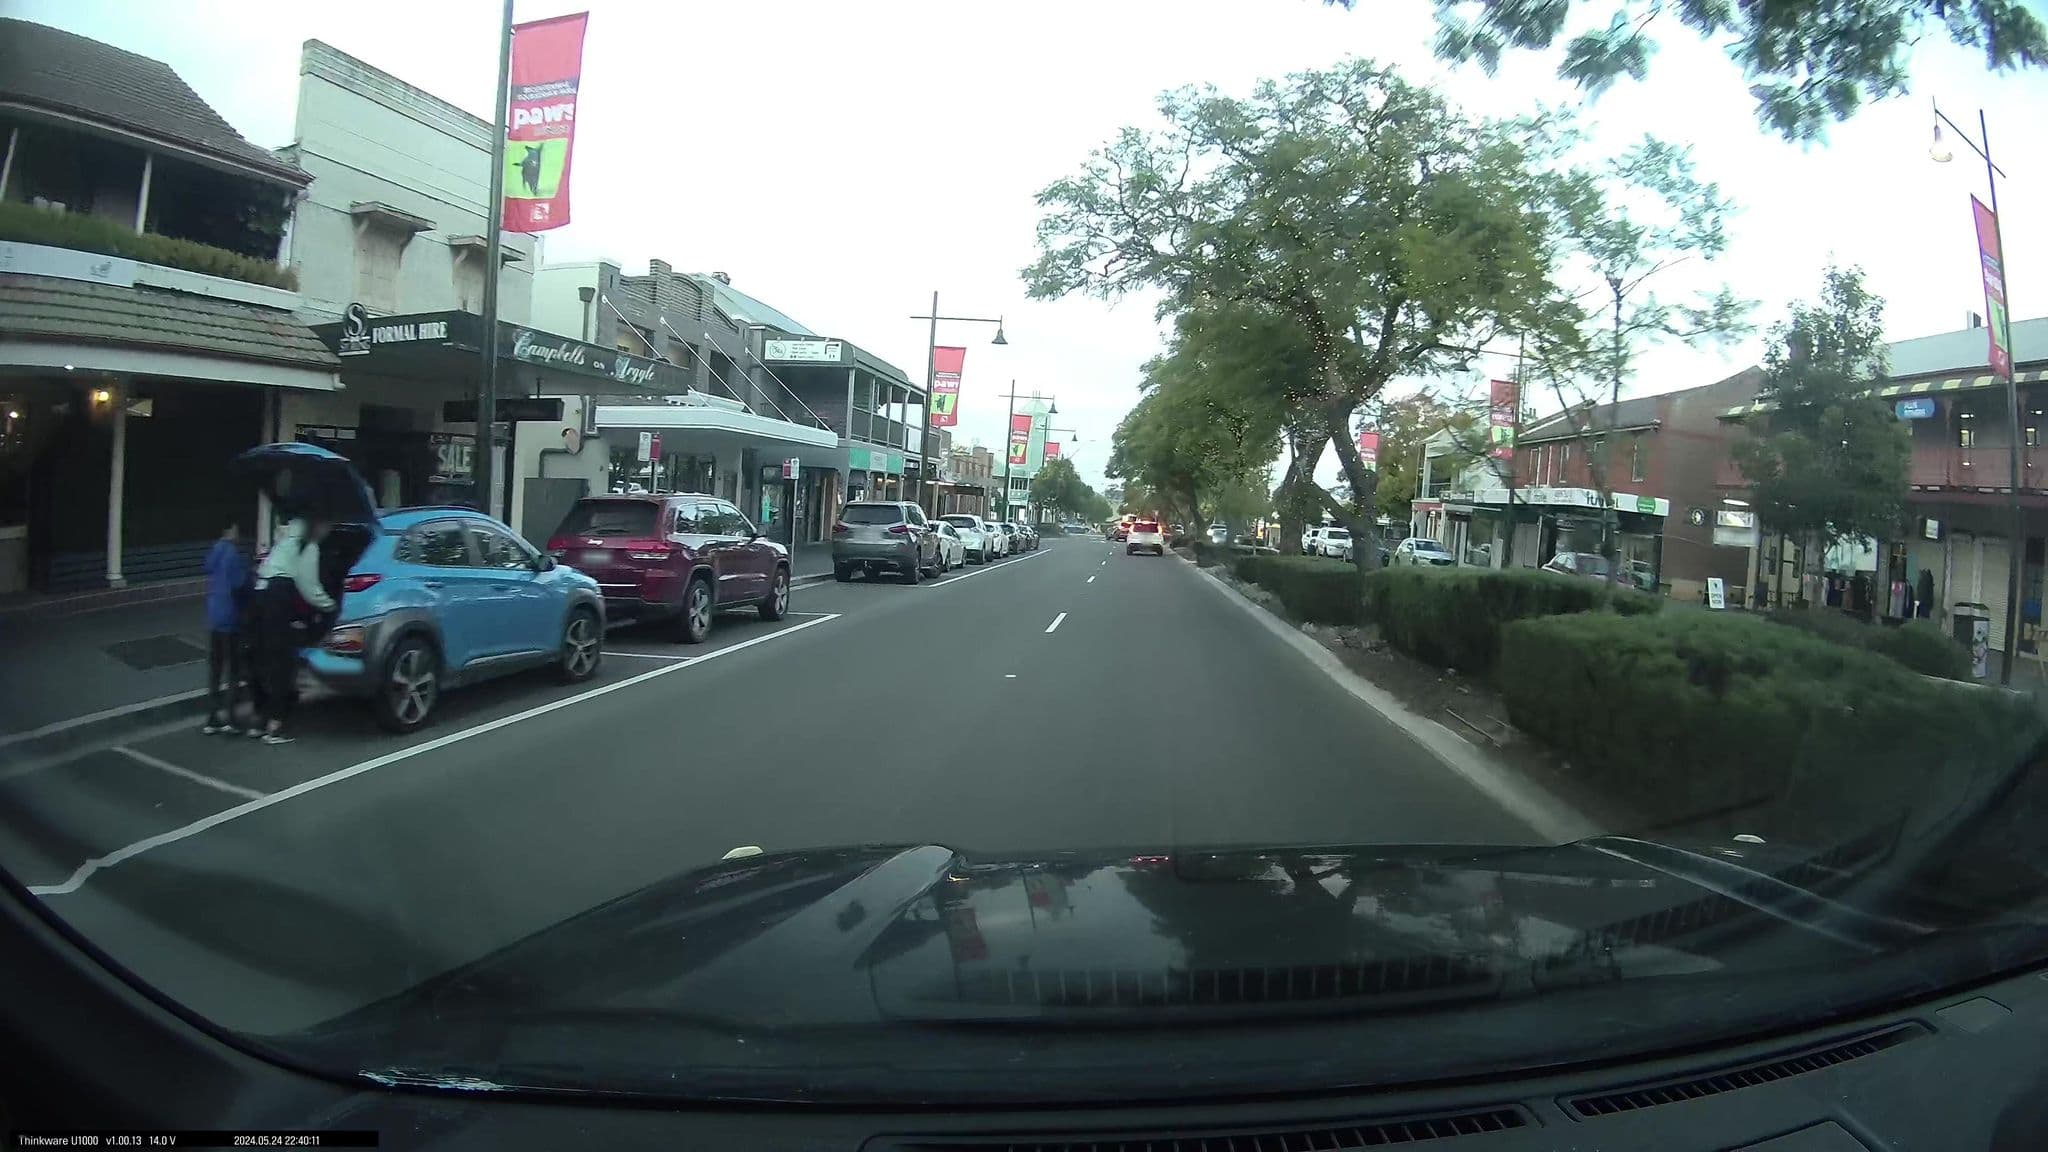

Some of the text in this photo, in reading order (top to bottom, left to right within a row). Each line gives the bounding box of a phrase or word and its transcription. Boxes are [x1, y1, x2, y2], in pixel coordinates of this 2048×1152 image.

[372, 322, 448, 343] FORMAL HIRE
[512, 329, 585, 364] Campbells
[611, 356, 655, 383] Argyle
[438, 444, 472, 472] SALE
